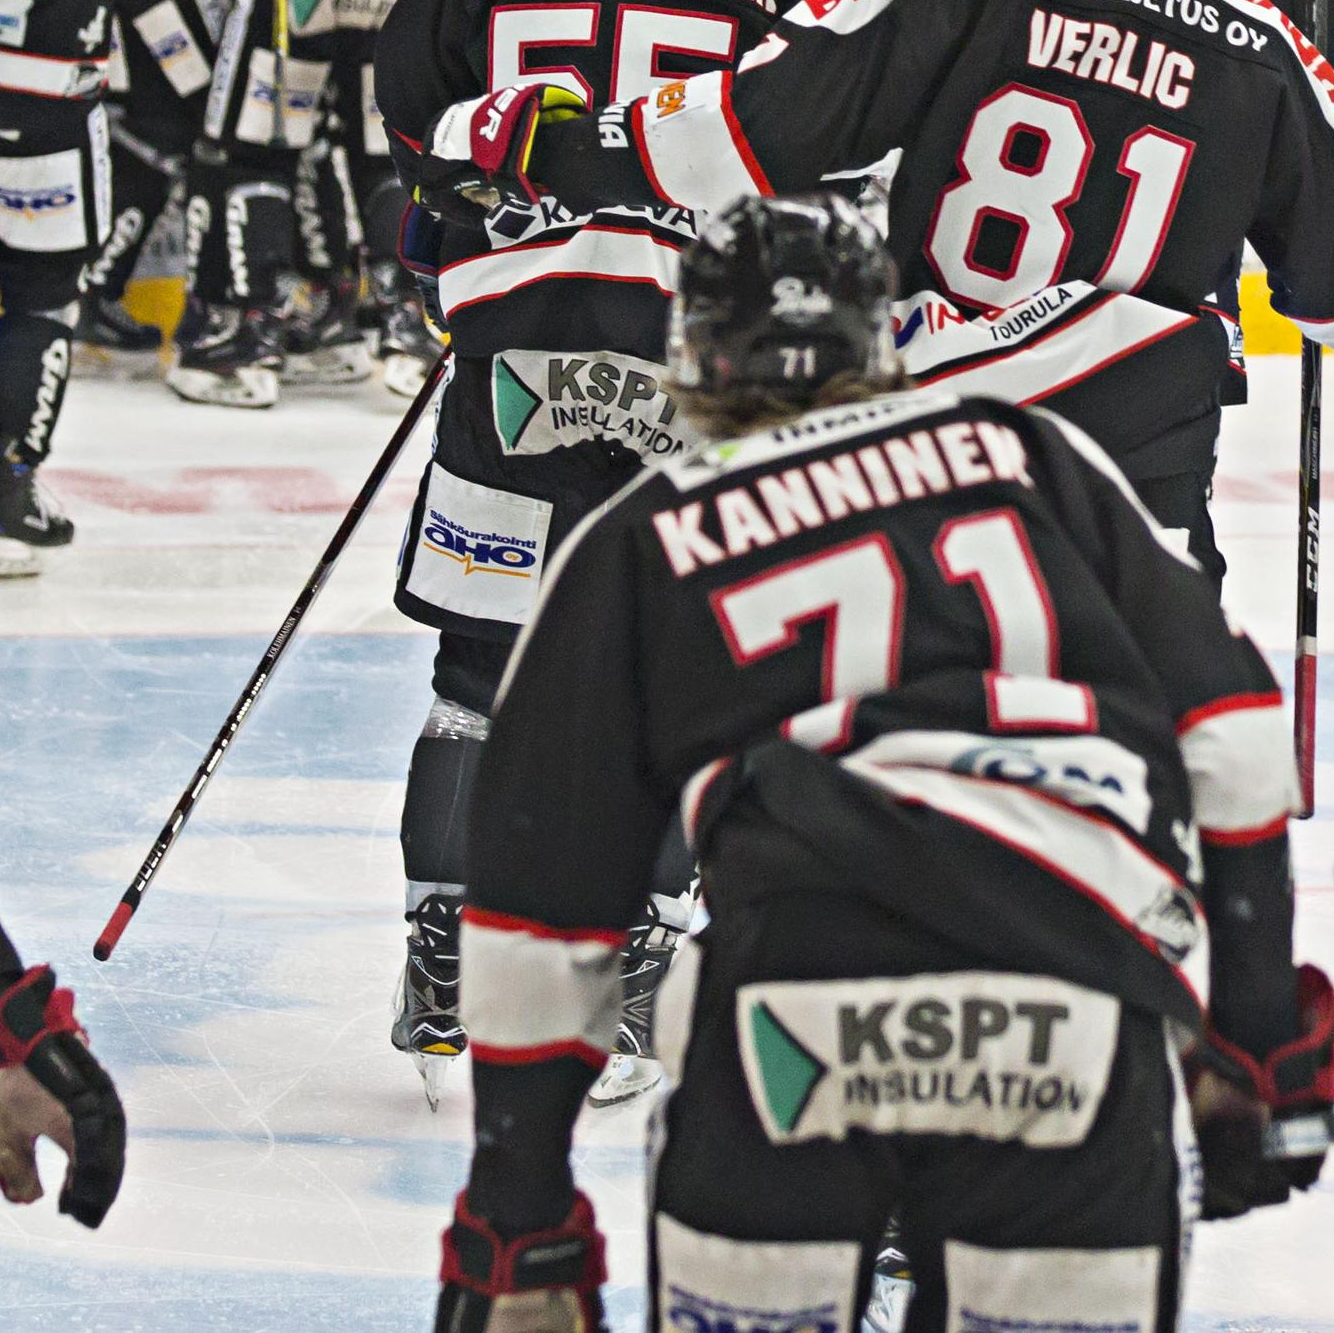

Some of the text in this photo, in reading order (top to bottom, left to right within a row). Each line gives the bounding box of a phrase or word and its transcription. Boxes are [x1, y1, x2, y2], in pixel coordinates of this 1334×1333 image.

[1026, 8, 1195, 111] VERLIC
[1225, 19, 1269, 53] OY
[922, 81, 1197, 311] 81
[778, 347, 817, 380] 71
[430, 509, 537, 550] Sähköurakointi
[652, 418, 1036, 578] KANNINEN
[1305, 505, 1319, 593] CCM
[709, 505, 1098, 735] 71
[837, 997, 1070, 1065] KSPT
[843, 1068, 1083, 1113] INSULATION
